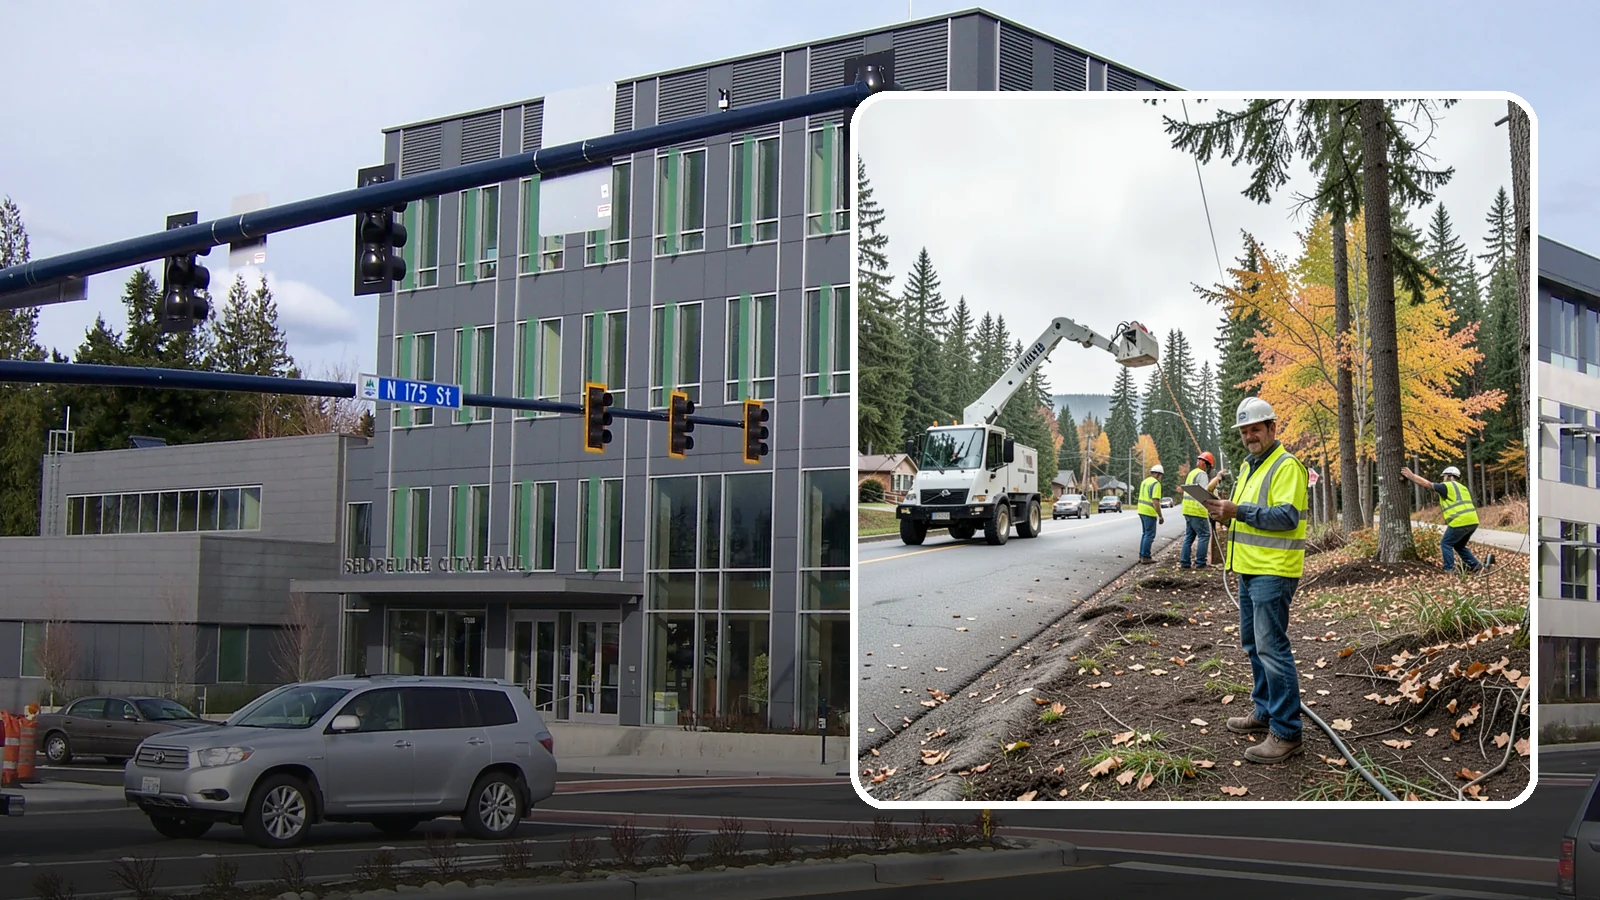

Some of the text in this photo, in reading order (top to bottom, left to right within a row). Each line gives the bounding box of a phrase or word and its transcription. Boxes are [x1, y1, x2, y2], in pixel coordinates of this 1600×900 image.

[387, 380, 452, 406] N 175 St
[344, 556, 525, 574] SHORELINE CITY HALL
